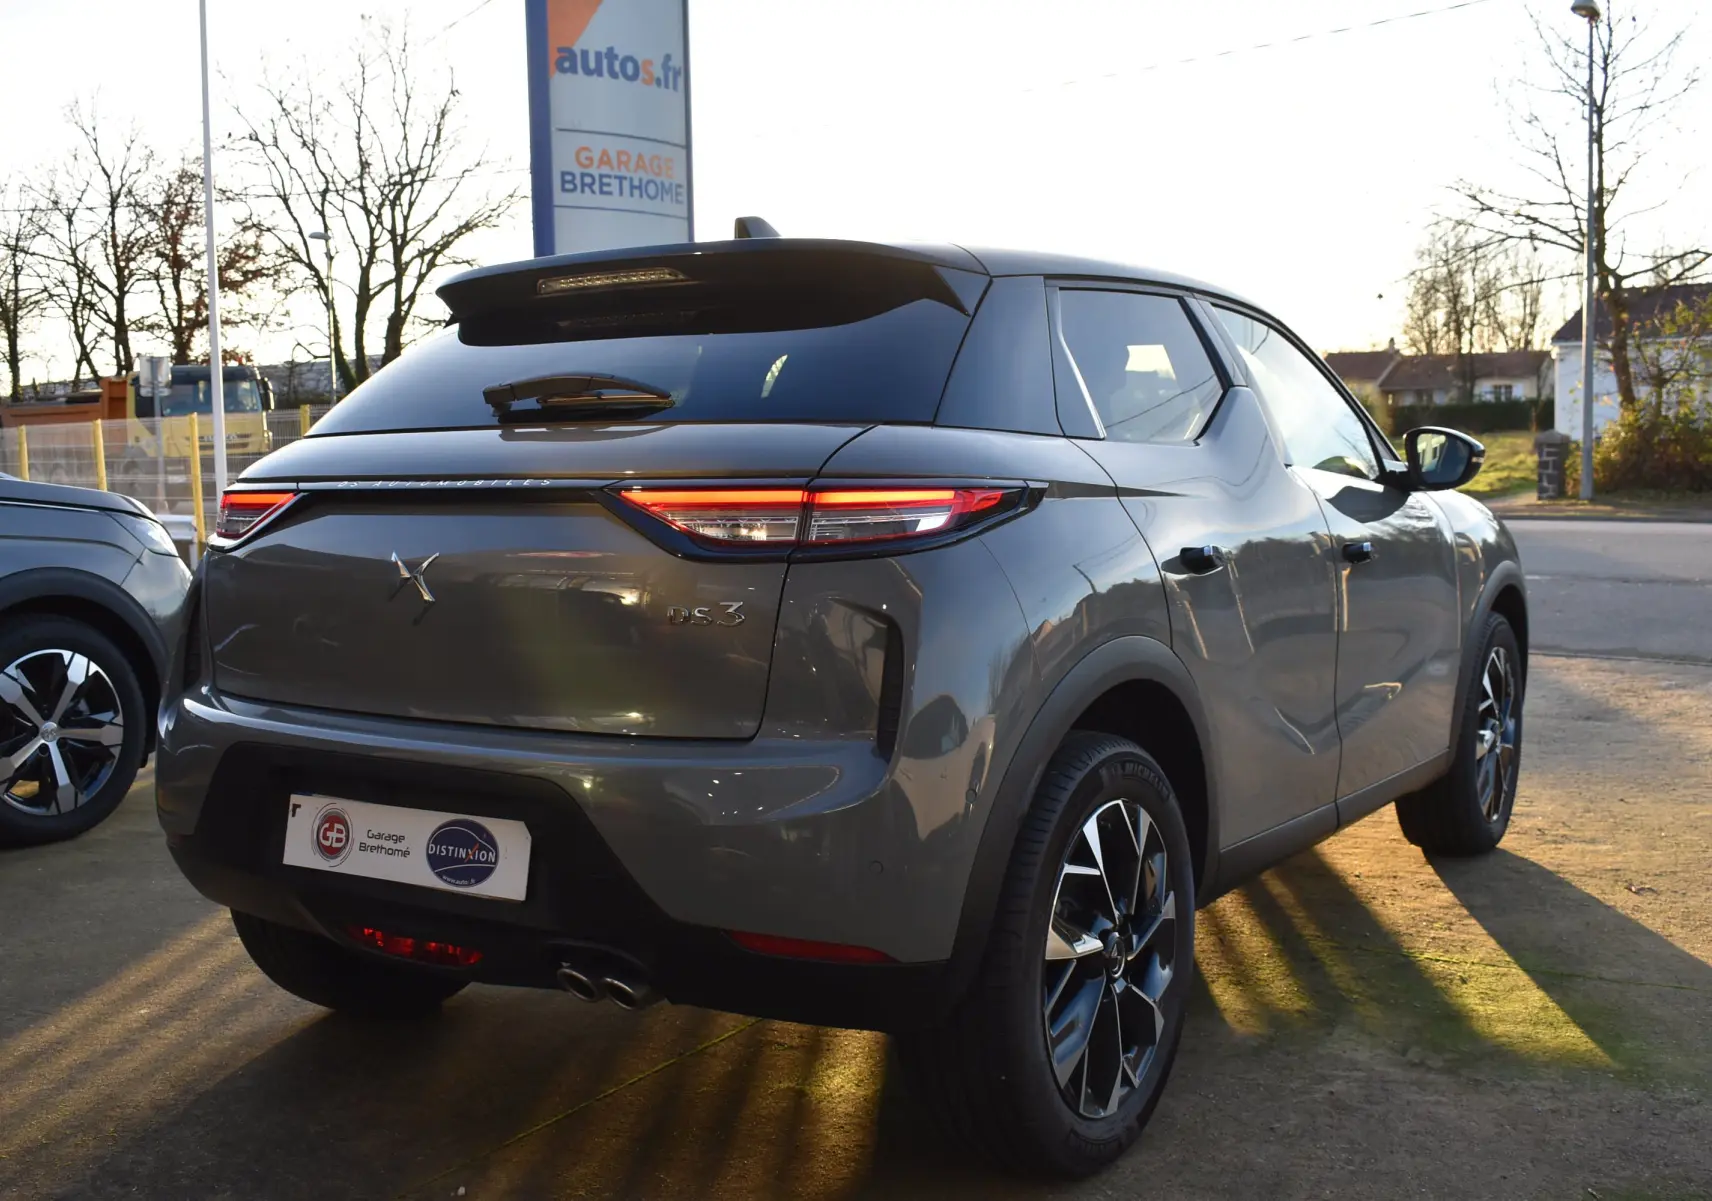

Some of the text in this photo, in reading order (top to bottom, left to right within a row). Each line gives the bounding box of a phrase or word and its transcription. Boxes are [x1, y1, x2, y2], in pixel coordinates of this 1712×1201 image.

[555, 46, 682, 92] autos.fr
[574, 146, 675, 179] GARAGE
[560, 171, 685, 205] BRETHOME
[667, 601, 746, 627] DS 3
[366, 829, 406, 844] Garage
[358, 842, 411, 858] Brethomé
[428, 843, 496, 863] DISTINXION
[442, 875, 476, 885] www.auto.fr
